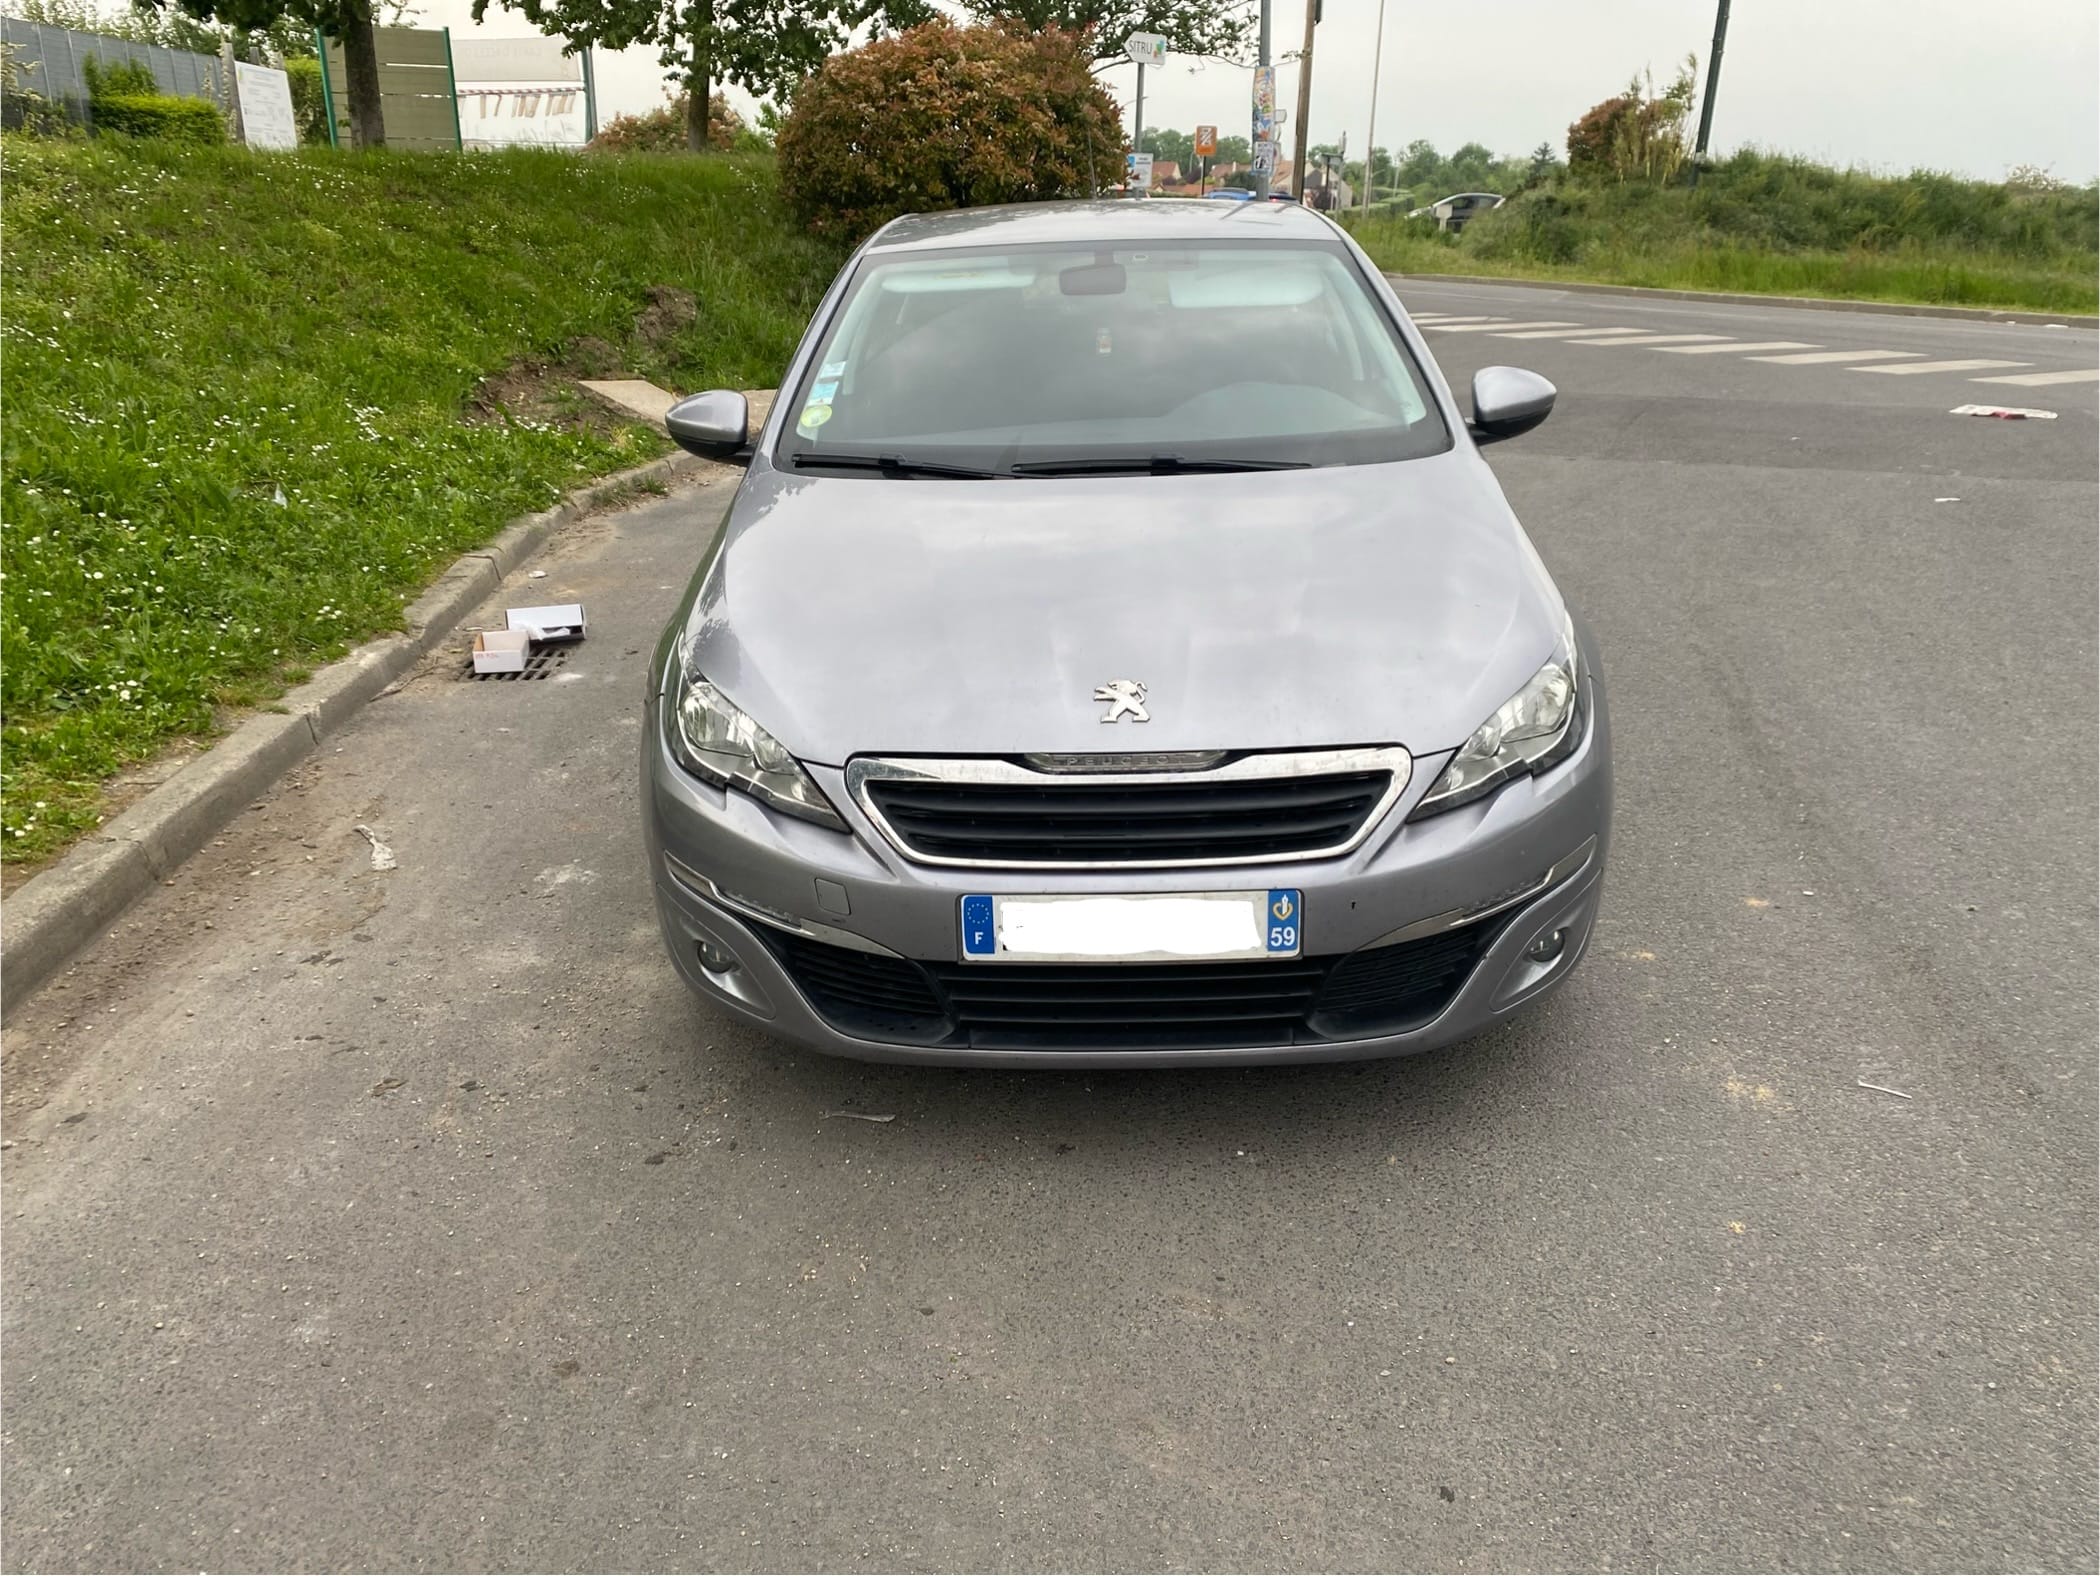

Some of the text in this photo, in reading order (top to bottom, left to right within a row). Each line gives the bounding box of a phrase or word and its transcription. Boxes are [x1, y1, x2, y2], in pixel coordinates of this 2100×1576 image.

[1129, 40, 1153, 55] SITRU
[975, 931, 984, 945] F
[1271, 926, 1296, 947] 59
